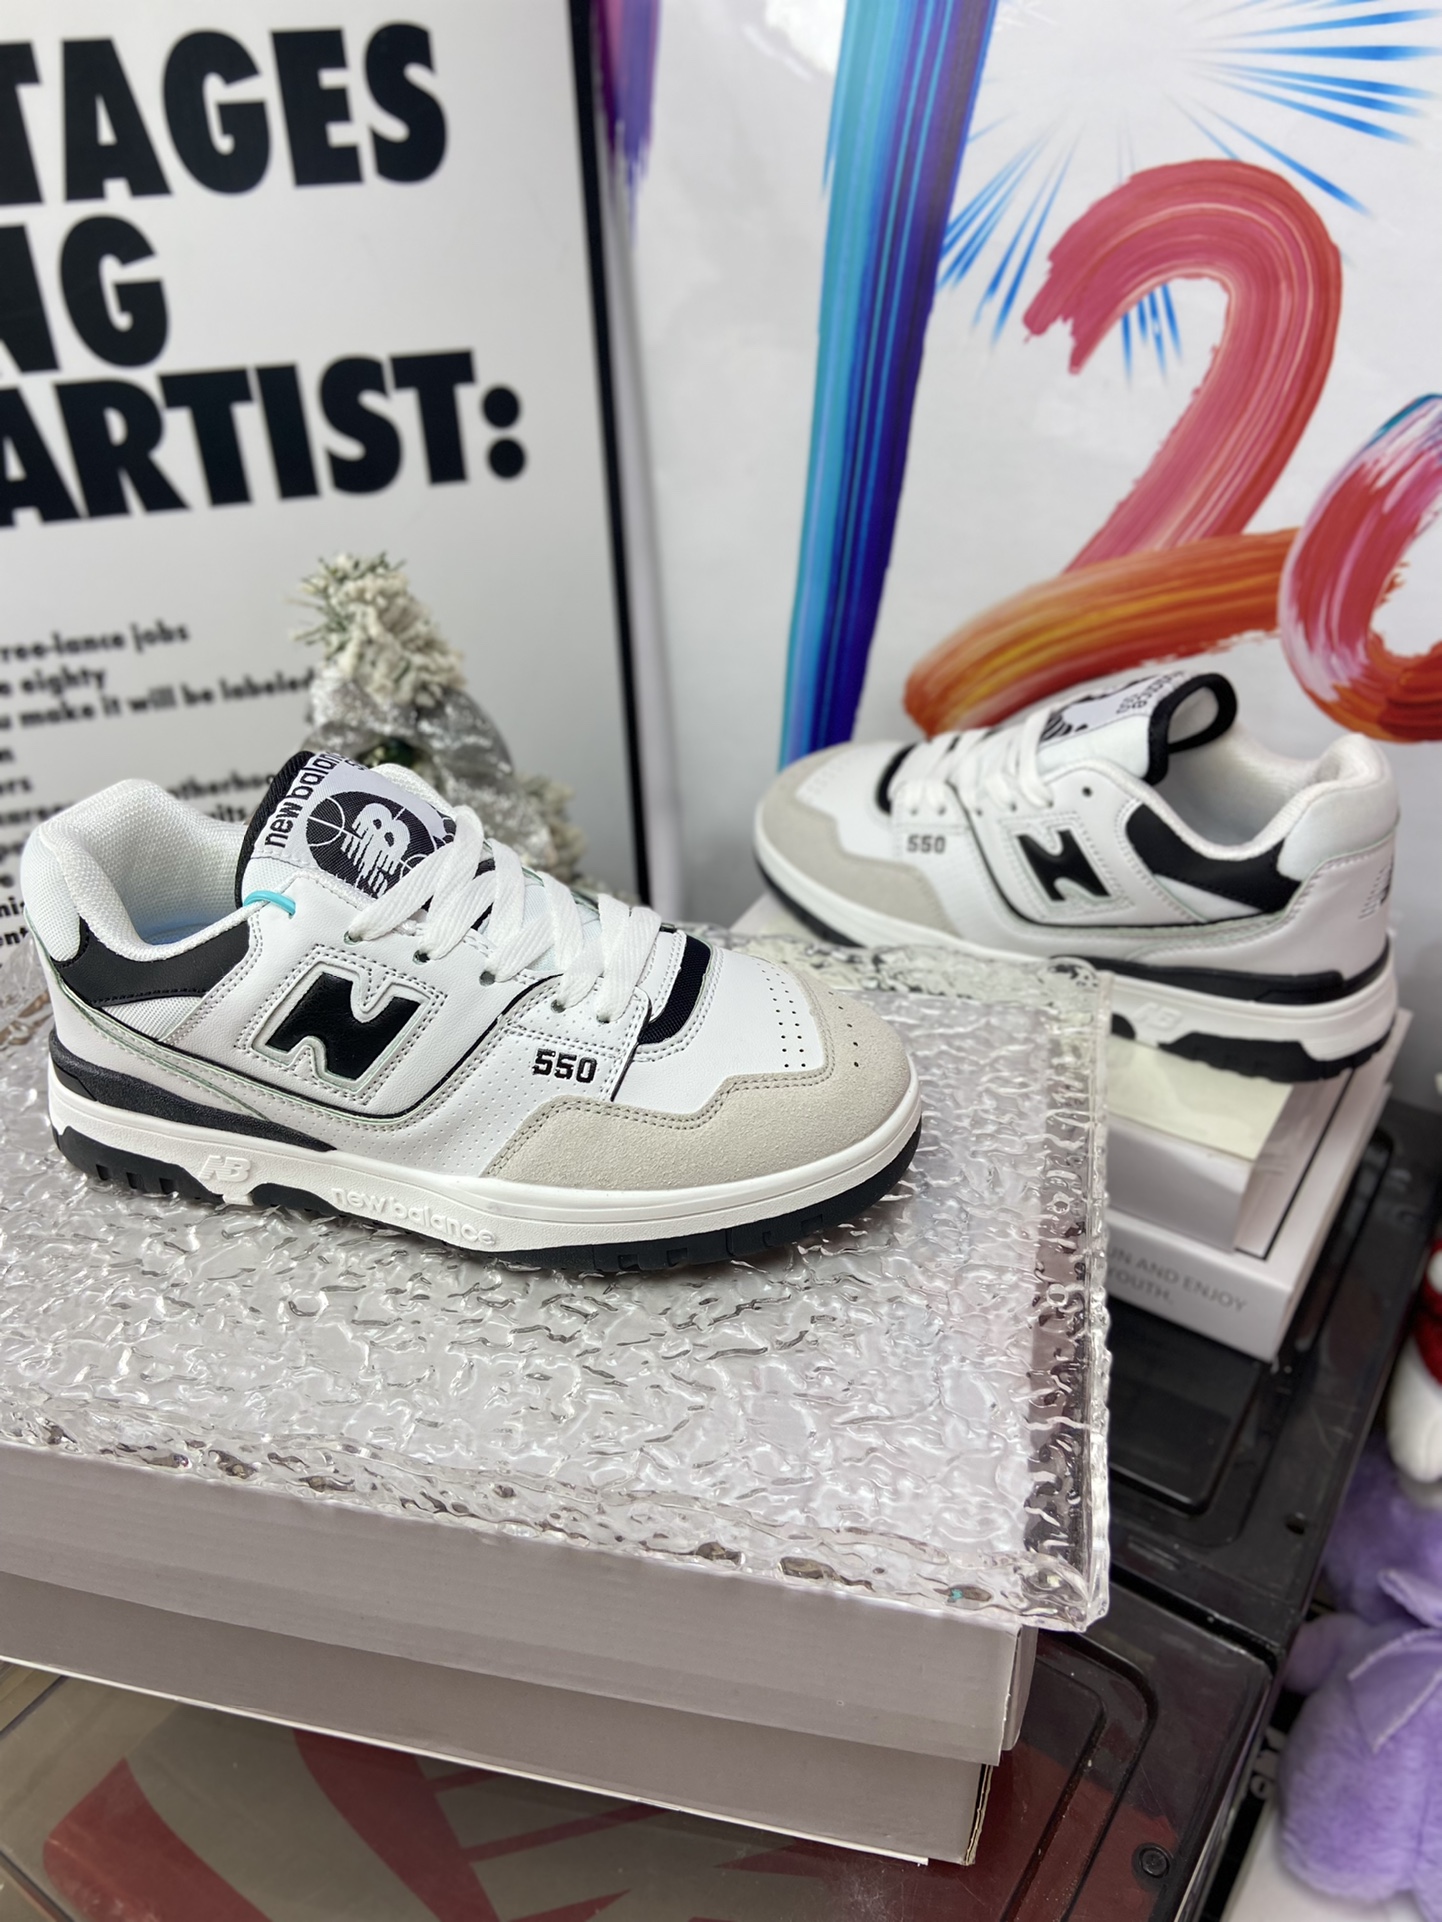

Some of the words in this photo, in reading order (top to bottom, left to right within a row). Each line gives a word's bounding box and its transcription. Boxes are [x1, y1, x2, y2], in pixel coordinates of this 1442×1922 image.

[131, 620, 189, 654] jobs
[180, 682, 213, 706] be
[283, 751, 346, 801] balan
[264, 801, 304, 849] new
[907, 834, 947, 855] 550
[531, 1048, 598, 1085] 550
[330, 1187, 387, 1214] new
[389, 1196, 497, 1247] balance
[1135, 1257, 1180, 1285] AND
[1182, 1273, 1248, 1313] ENJOY
